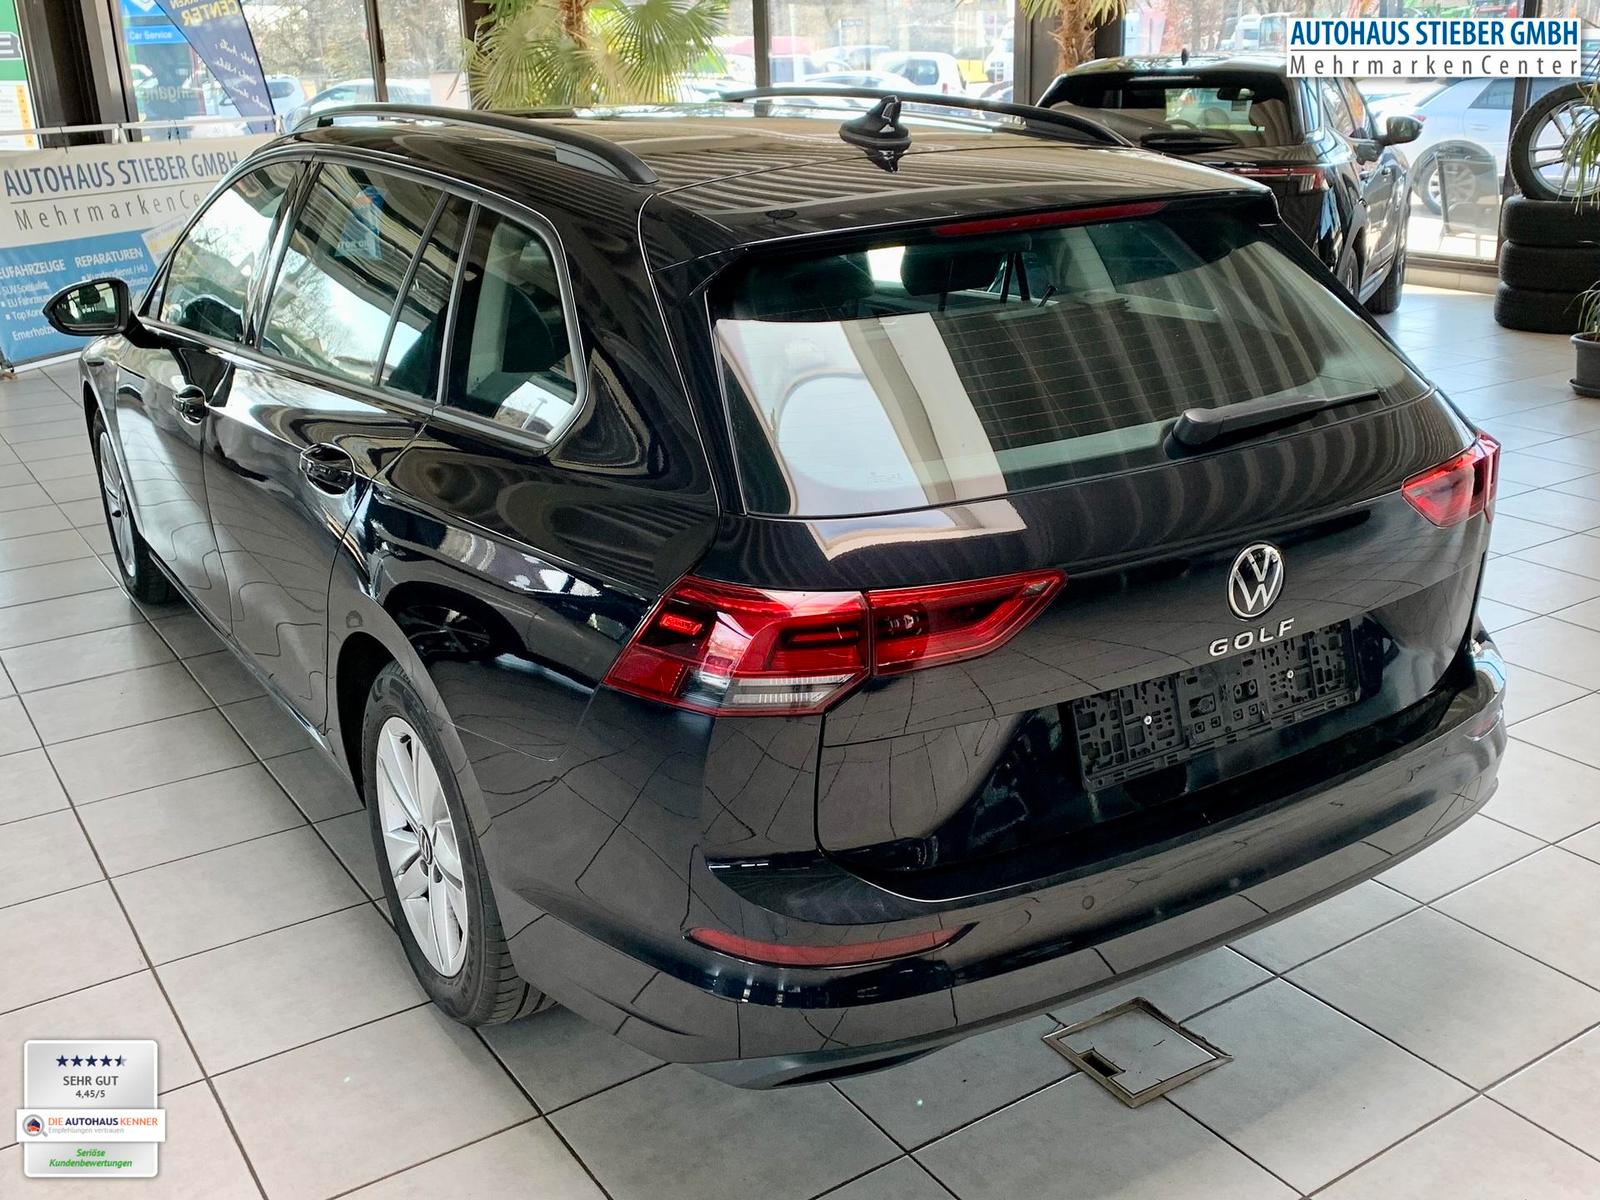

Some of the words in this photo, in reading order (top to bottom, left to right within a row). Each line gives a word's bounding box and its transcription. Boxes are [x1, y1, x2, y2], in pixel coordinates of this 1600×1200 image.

[4, 161, 115, 198] AUTOHAUS
[117, 154, 190, 186] STIEBER
[191, 150, 240, 178] GMBH
[14, 190, 209, 231] MehrmarkenCe
[0, 258, 66, 279] EUFAHRZEUGE
[74, 247, 144, 268] REPARATUREN
[1208, 617, 1295, 657] GOLF
